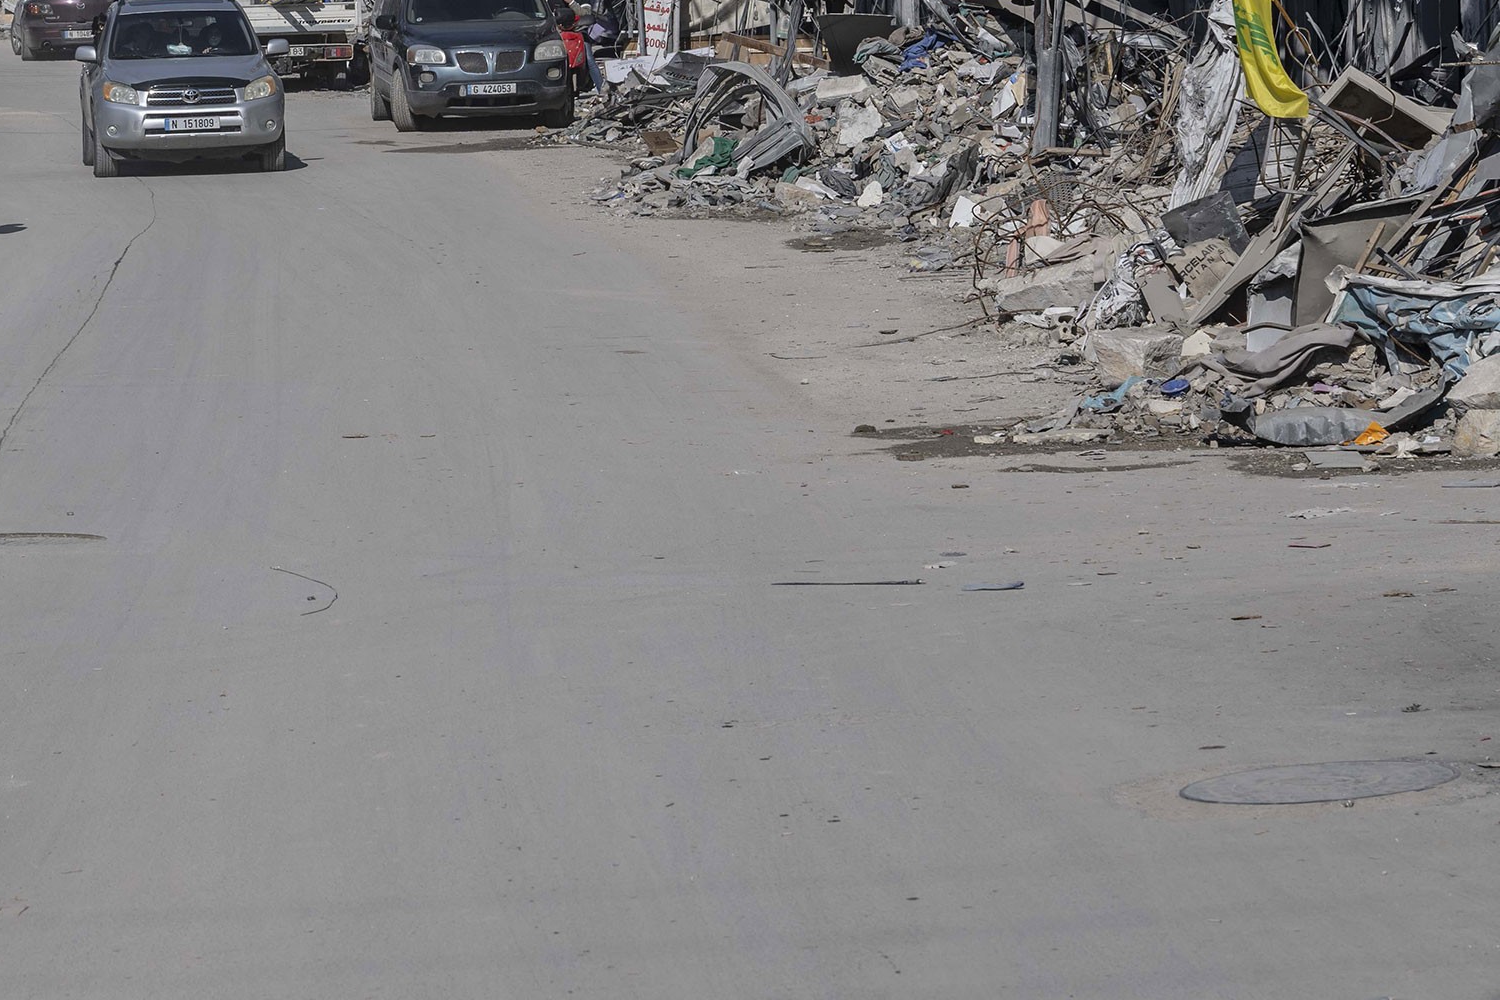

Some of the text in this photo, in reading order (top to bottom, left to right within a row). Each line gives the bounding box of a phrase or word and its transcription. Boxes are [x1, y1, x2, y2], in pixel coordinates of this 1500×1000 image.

[644, 23, 668, 33] للعمو
[473, 85, 511, 93] G 424053
[171, 118, 214, 129] N 151809
